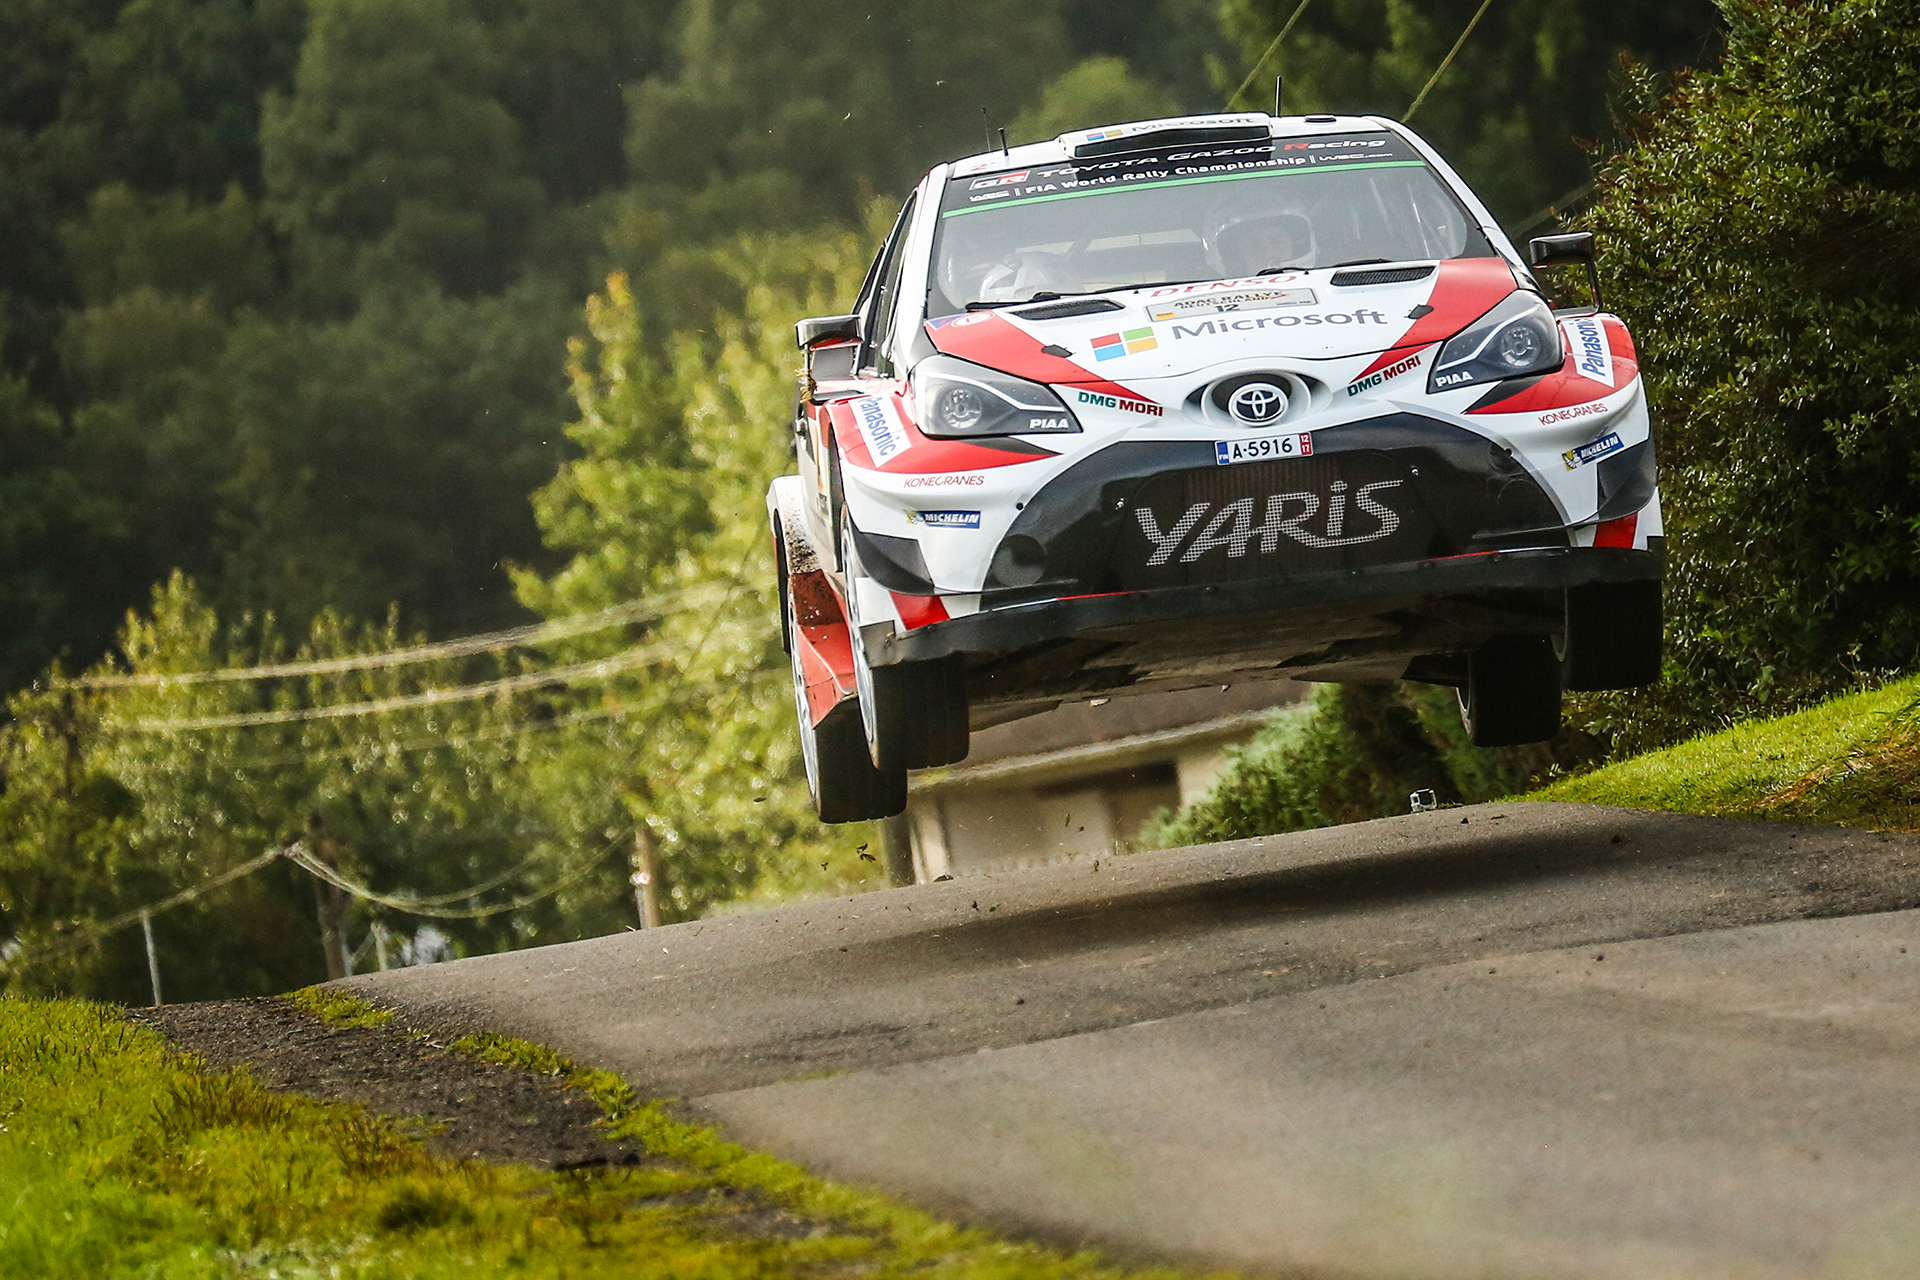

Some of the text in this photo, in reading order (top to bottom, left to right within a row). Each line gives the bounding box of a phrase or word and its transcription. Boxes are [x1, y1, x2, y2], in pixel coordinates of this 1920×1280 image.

[1132, 117, 1254, 132] Microsoft
[970, 139, 1386, 190] GR TOYOTA GAZOO Racing
[1025, 184, 1058, 195] FIA
[1061, 172, 1117, 189] World
[1122, 169, 1169, 183] Rally
[1174, 156, 1306, 174] Championship
[1150, 275, 1297, 297] DENSO
[1174, 290, 1284, 308] ADAC RALLYE
[1214, 303, 1241, 313] 12
[1171, 309, 1388, 340] Microsoft
[1347, 355, 1422, 397] DMG MORI
[1435, 371, 1474, 388] PIAA
[1078, 391, 1164, 417] DMG MORI
[1538, 403, 1608, 426] KONECRANES
[858, 396, 897, 457] Panasonic
[1029, 418, 1070, 429] PIAA
[1580, 435, 1619, 459] MICHELIN
[904, 475, 985, 489] KONECRANES
[924, 513, 980, 524] MICHELIN
